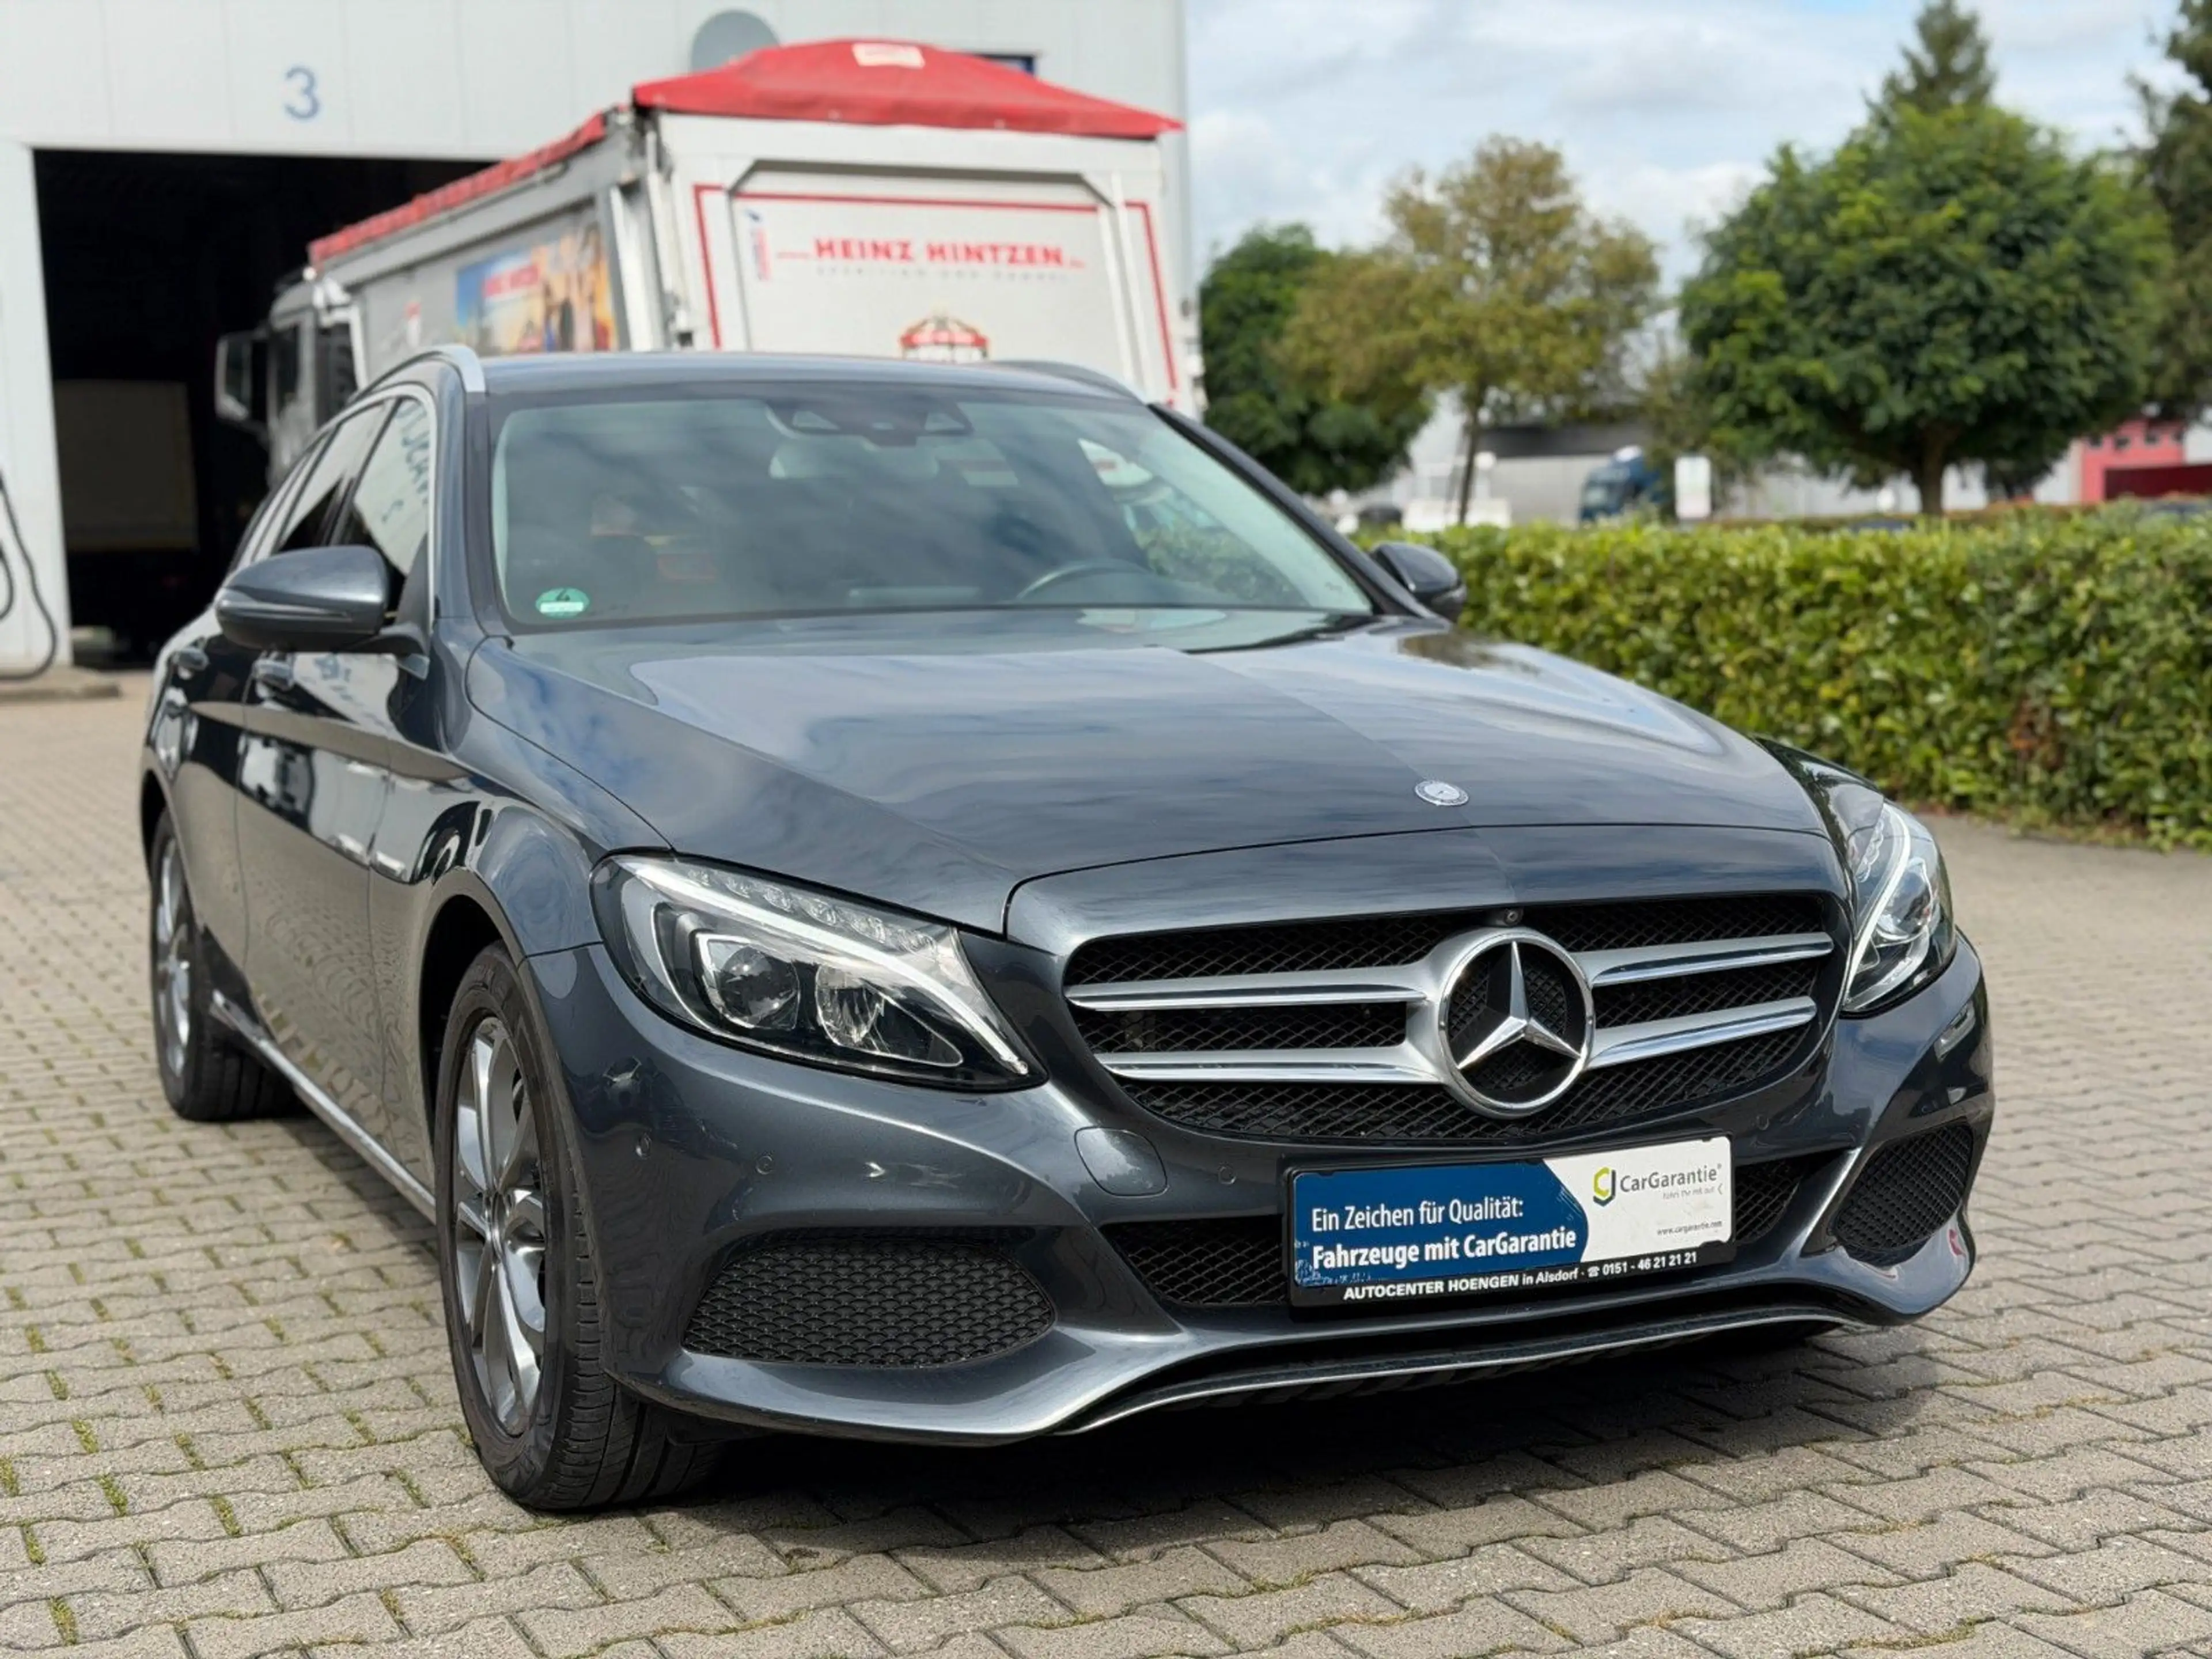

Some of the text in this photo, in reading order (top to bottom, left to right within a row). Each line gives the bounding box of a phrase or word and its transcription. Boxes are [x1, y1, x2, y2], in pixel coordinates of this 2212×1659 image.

[285, 66, 320, 119] 3
[815, 238, 1063, 266] HEINZ HINTZEN
[1312, 1195, 1524, 1232] Ein Zeichen für Qualität:
[1313, 1225, 1577, 1270] Fahrzeuge mit CarGarantie
[1343, 1278, 1444, 1300] AUTOCENTER
[1448, 1273, 1519, 1292] HOENGEN
[1522, 1274, 1533, 1285] in
[1535, 1268, 1579, 1283] Alsdorf
[1603, 1262, 1627, 1276] 0151
[1638, 1258, 1650, 1270] 46
[1654, 1256, 1665, 1269] 21
[1669, 1254, 1681, 1266] 21
[1684, 1251, 1696, 1264] 21
